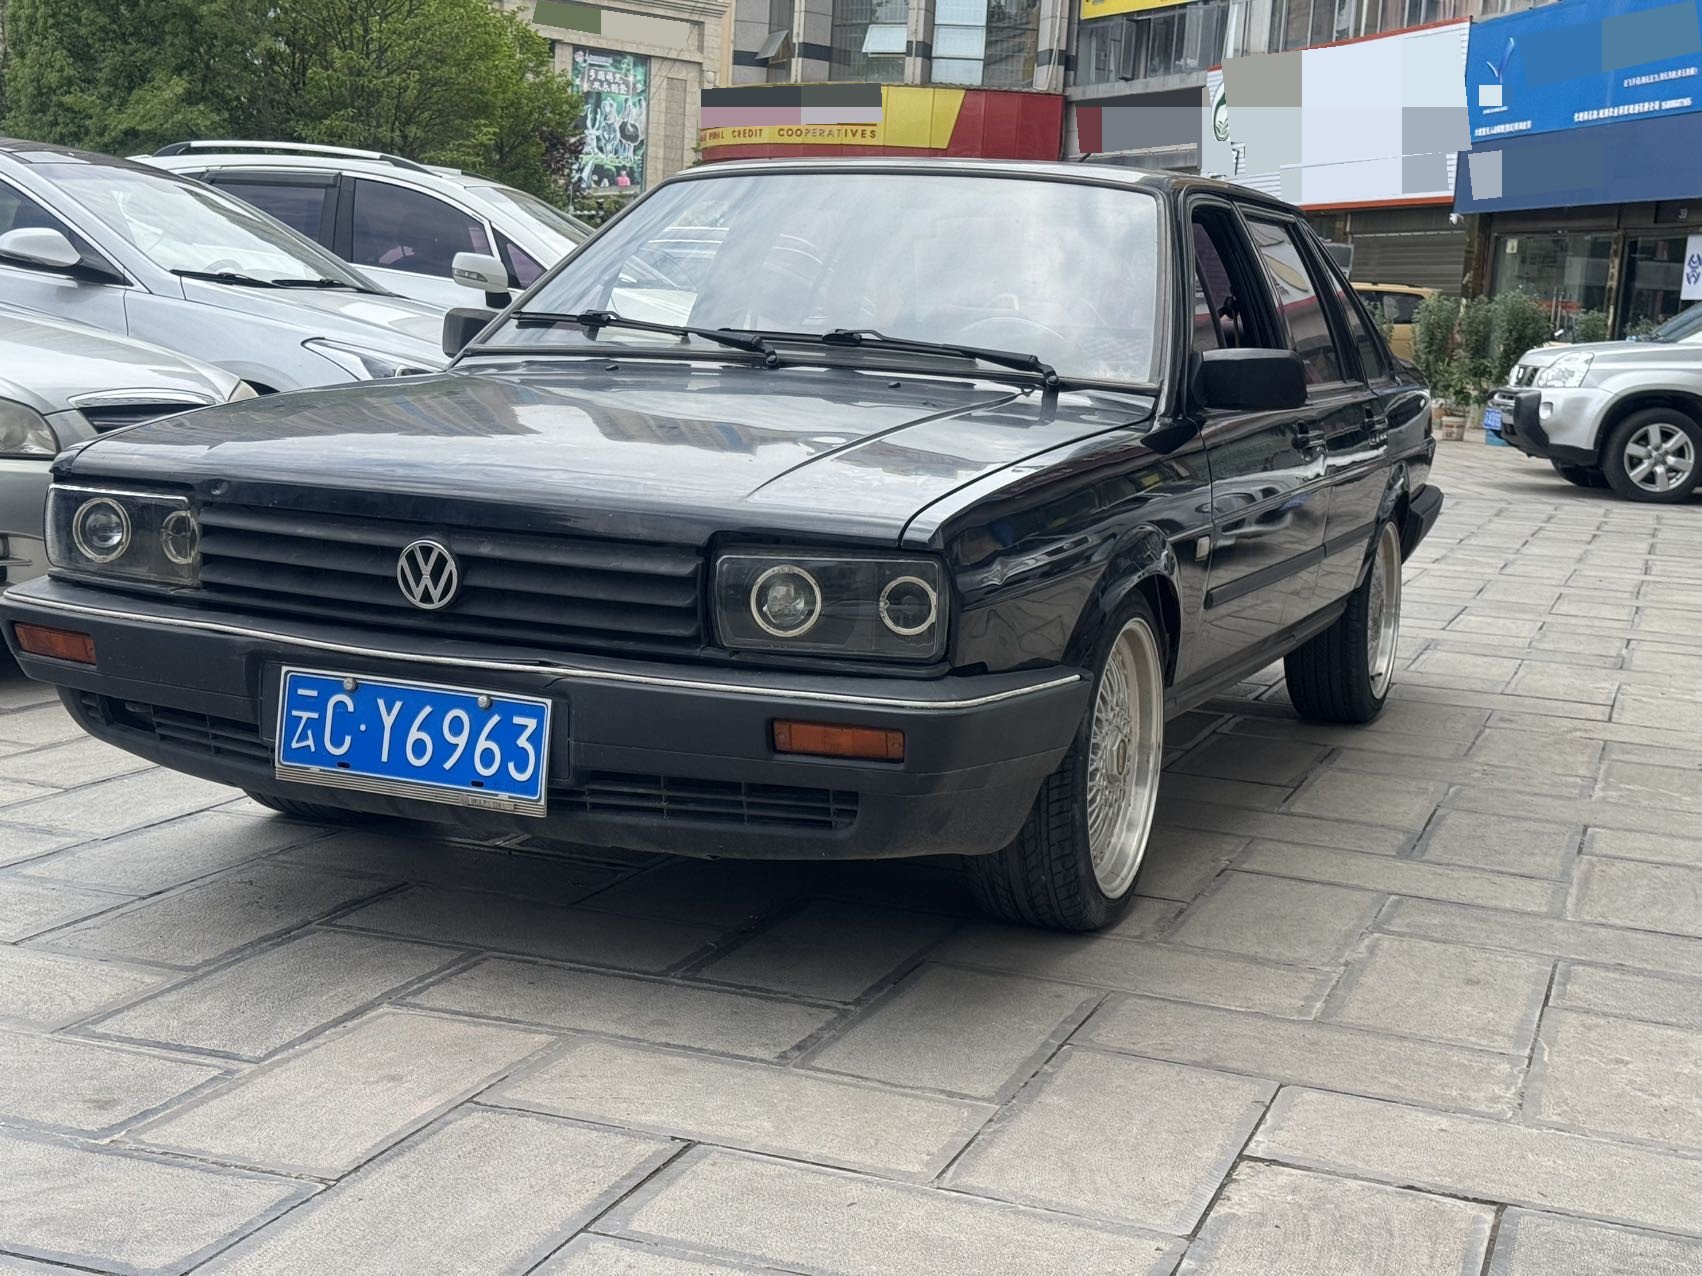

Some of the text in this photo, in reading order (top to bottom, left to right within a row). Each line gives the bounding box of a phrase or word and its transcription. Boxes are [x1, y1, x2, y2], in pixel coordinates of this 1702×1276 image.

[731, 128, 763, 138] CREDIT
[777, 127, 877, 139] COOPERATIVES
[397, 540, 458, 609] VW
